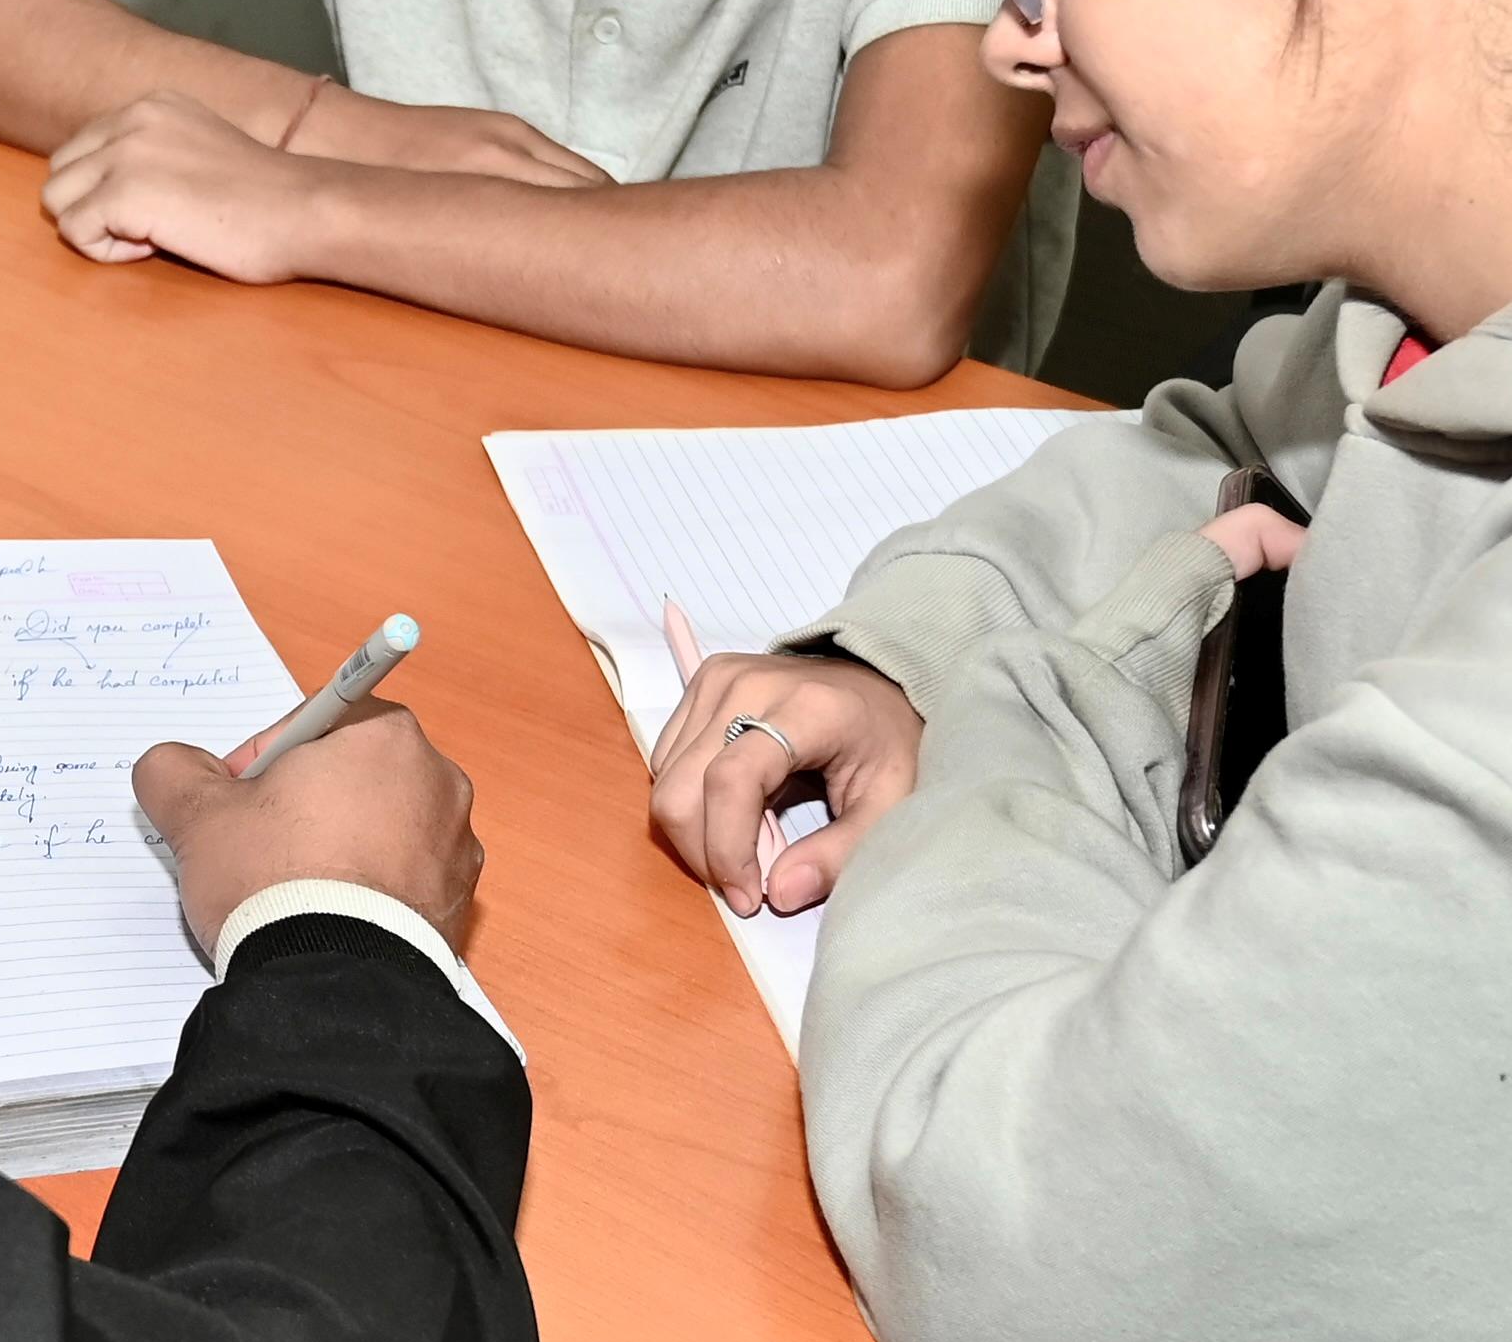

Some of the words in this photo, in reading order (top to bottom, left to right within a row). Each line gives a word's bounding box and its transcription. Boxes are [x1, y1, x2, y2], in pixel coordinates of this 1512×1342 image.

[86, 621, 128, 644] you
[141, 612, 213, 639] complete
[11, 665, 40, 702] if
[52, 666, 75, 689] he
[97, 668, 140, 689] had
[149, 664, 241, 696] completed
[53, 761, 97, 775] some
[33, 824, 63, 860] if
[84, 818, 108, 845] he
